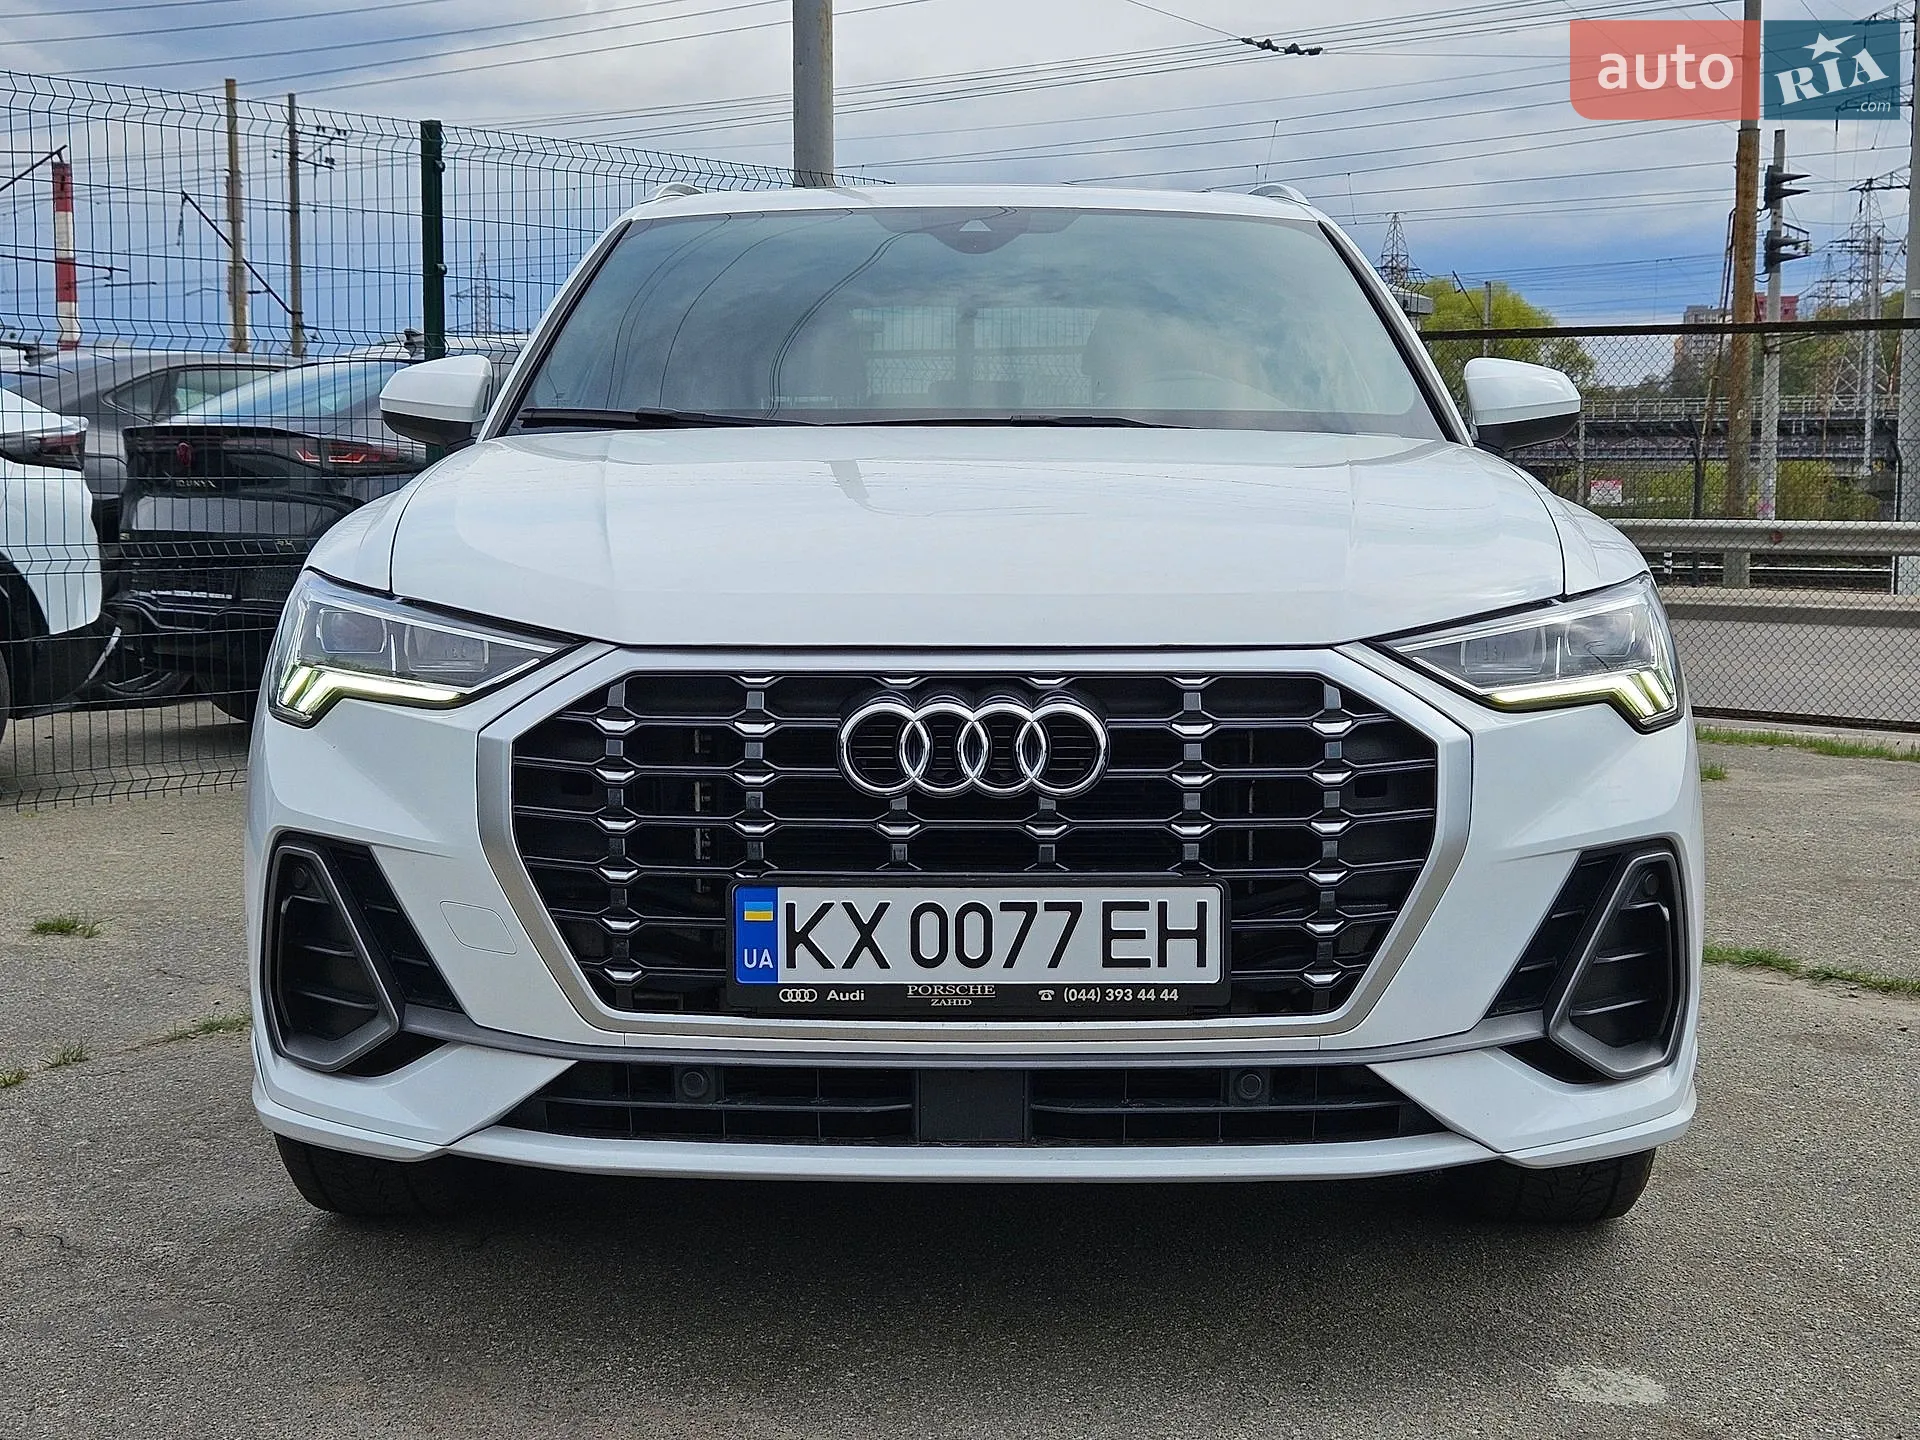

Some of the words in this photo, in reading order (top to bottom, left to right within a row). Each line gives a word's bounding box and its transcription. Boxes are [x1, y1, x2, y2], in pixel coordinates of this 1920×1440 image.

[785, 901, 892, 969] KX
[909, 901, 1084, 969] 0077
[1101, 901, 1208, 968] EH
[744, 949, 773, 969] UA
[827, 989, 865, 1001] Audi
[907, 985, 996, 995] PORSCHE
[1063, 987, 1101, 1003] (044)
[1105, 988, 1133, 1001] 393
[1137, 988, 1156, 1001] 44
[1159, 988, 1179, 1001] 44
